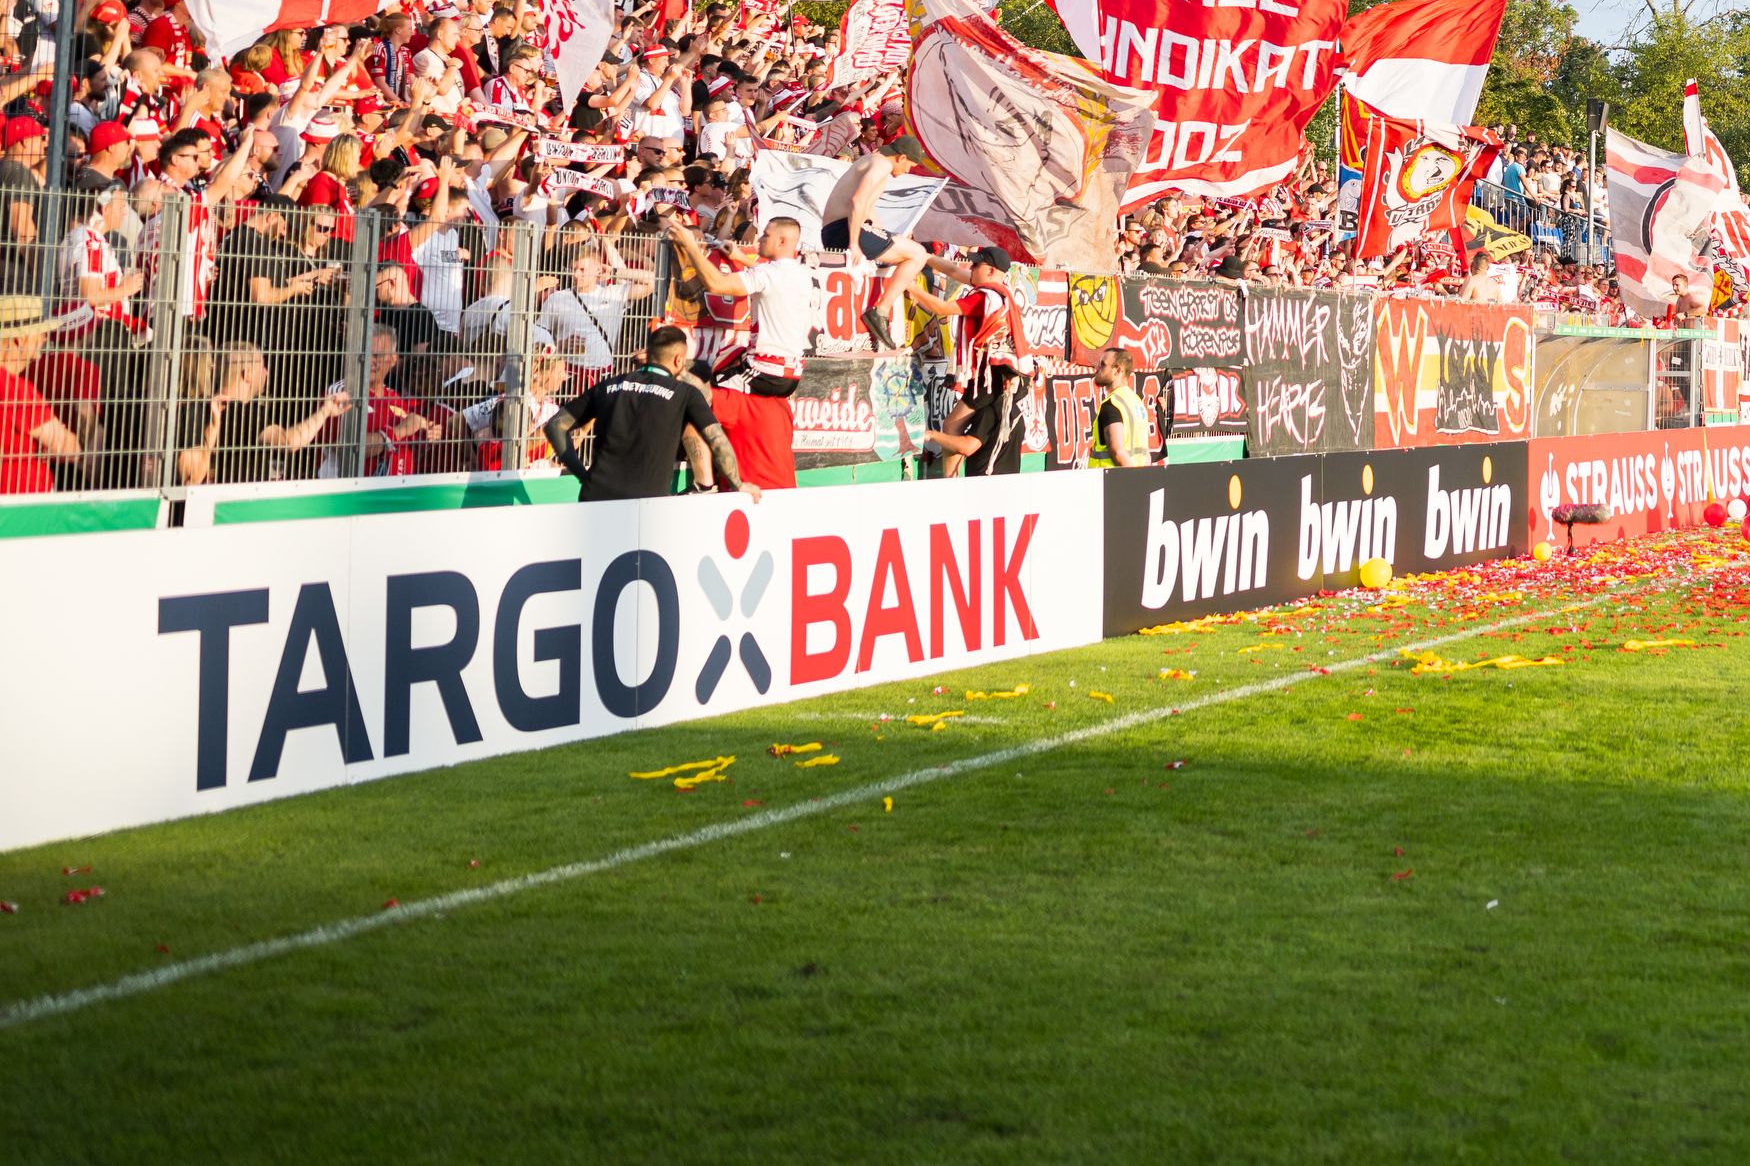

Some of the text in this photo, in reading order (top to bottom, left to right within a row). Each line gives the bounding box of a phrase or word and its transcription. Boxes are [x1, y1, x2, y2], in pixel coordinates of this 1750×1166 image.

[1141, 456, 1512, 610] bwin bwin bwin
[1566, 452, 1658, 517] STRAUSS
[158, 513, 1040, 792] TARGO BANK
